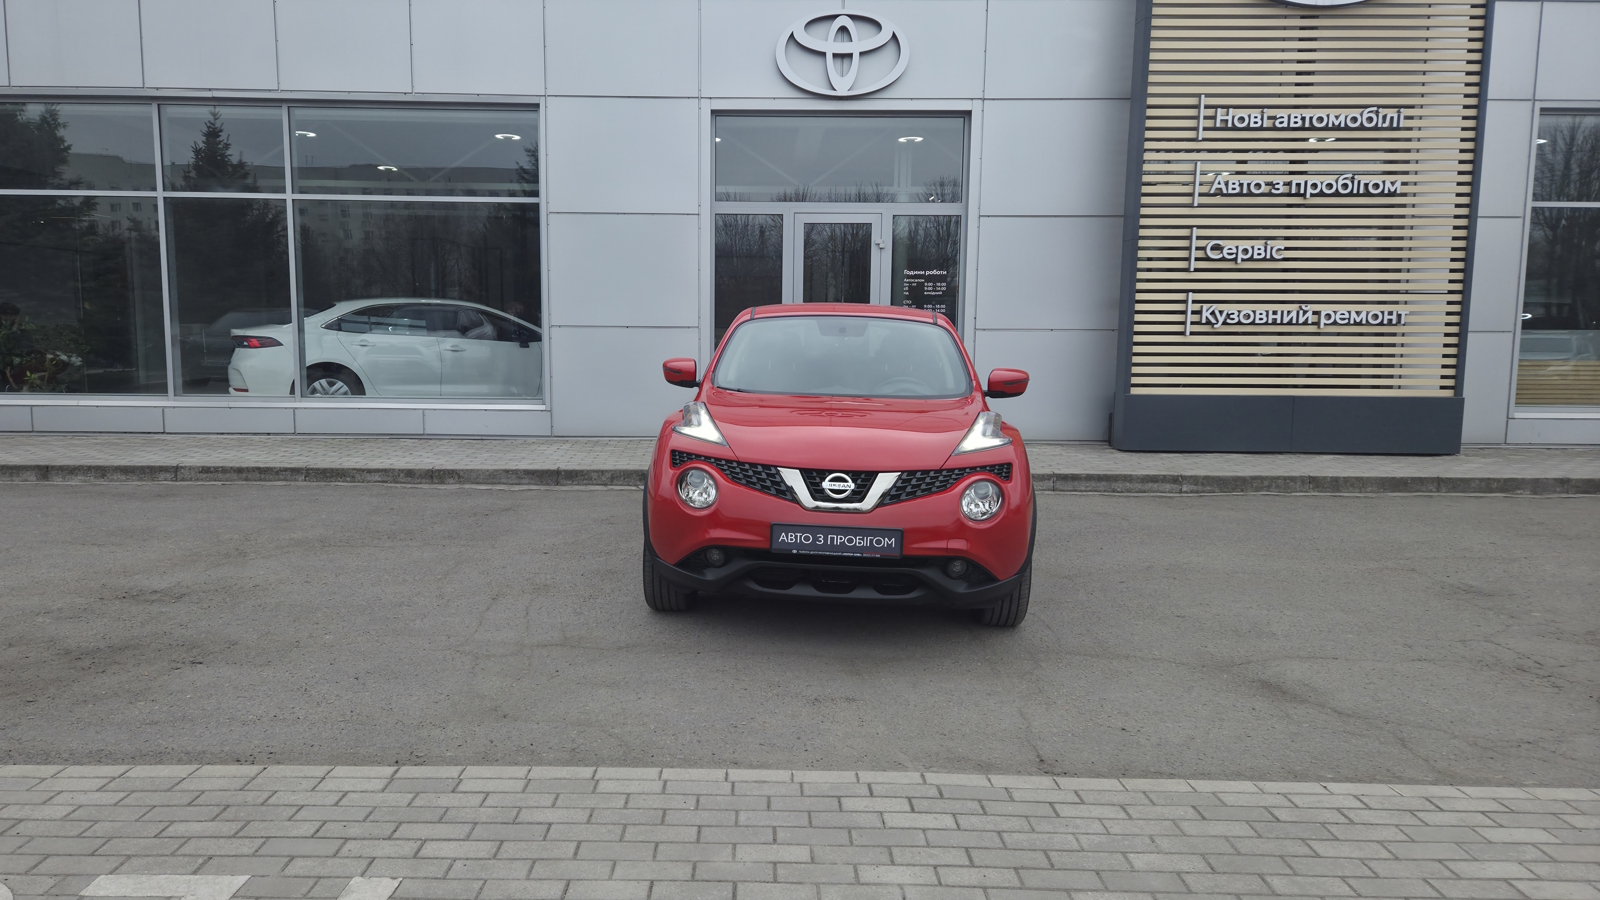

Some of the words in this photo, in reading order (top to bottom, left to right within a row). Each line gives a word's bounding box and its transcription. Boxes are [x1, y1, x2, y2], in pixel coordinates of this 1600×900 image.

[1215, 107, 1268, 128] Нові
[1274, 106, 1405, 128] автомобілі
[1208, 174, 1265, 195] Авто
[1271, 180, 1284, 195] з
[1291, 173, 1402, 199] пробігом
[1205, 240, 1285, 264] Сервіс
[1200, 304, 1313, 328] Кузовний
[1319, 310, 1409, 328] ремонт
[778, 532, 813, 544] АВТО
[816, 534, 824, 545] З
[827, 534, 895, 548] ПРОБІГОМ
